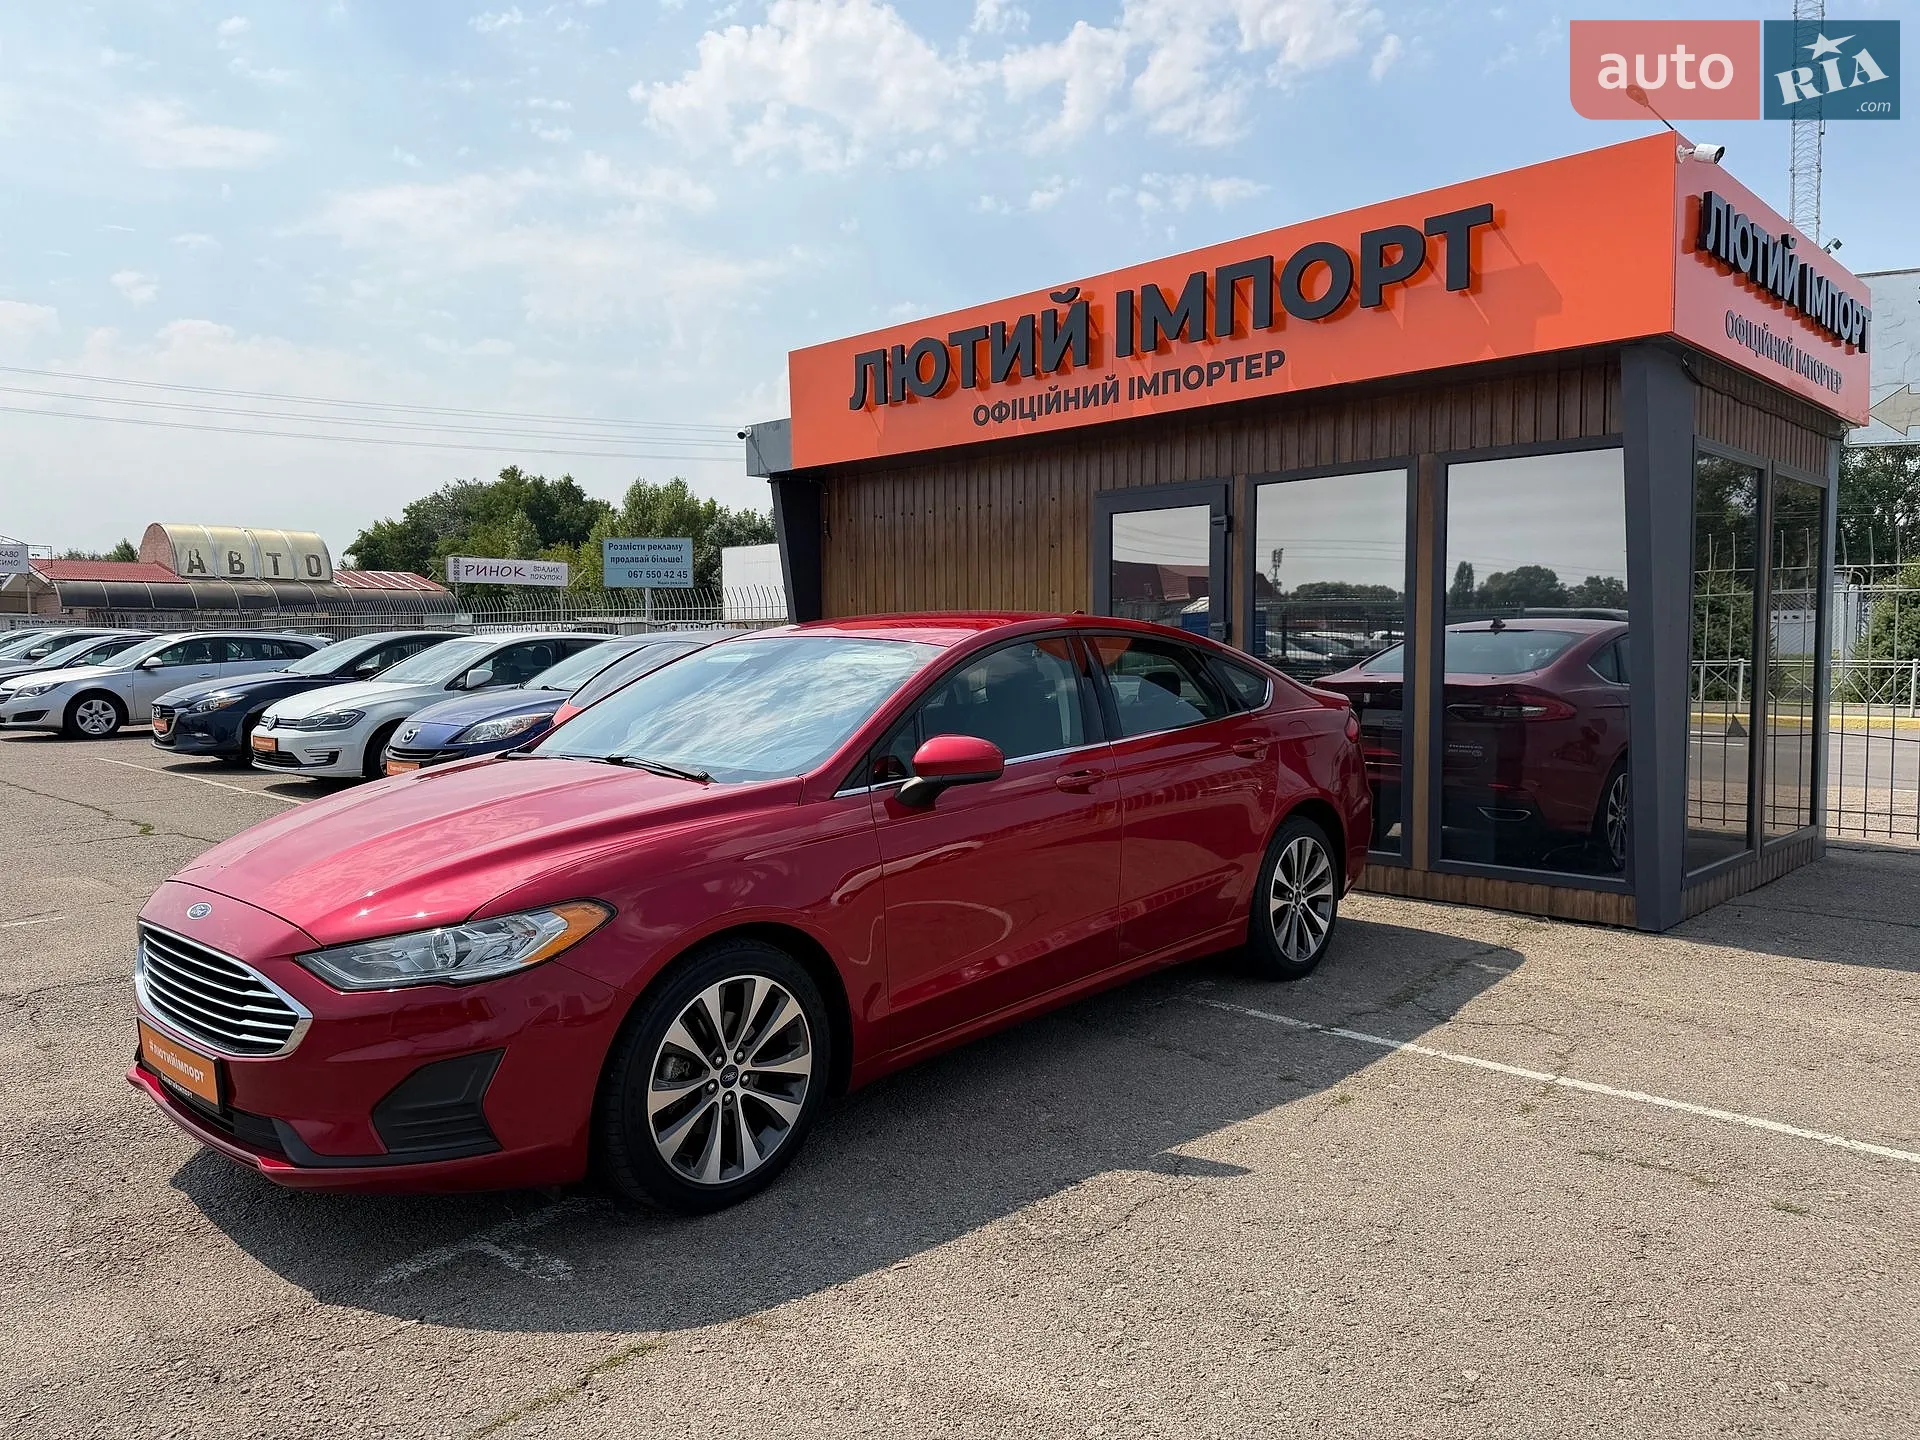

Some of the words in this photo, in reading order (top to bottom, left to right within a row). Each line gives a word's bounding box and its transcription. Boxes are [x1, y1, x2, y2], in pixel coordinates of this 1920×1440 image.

[1703, 190, 1800, 309] ЛЮТИЙ
[1799, 263, 1872, 354] ІМПОРТ
[849, 286, 1090, 411] ЛЮТИЙ
[1115, 203, 1494, 358] ІМПОРТ
[1725, 309, 1794, 371] ОФІЦІЙНИЙ
[1795, 348, 1843, 395] ІМПОРТЕР
[973, 373, 1120, 427] ОФІЦІЙНИЙ
[1128, 349, 1286, 401] ІМПОРТЕР
[608, 542, 646, 551] Розмісти
[647, 544, 684, 552] рекламу
[610, 555, 650, 564] продавай
[651, 555, 683, 563] більше!
[187, 548, 322, 578] АВТО
[464, 564, 526, 577] РИНОК
[627, 570, 644, 579] 067
[646, 570, 661, 579] 550
[664, 570, 675, 579] 42
[676, 570, 688, 579] 45
